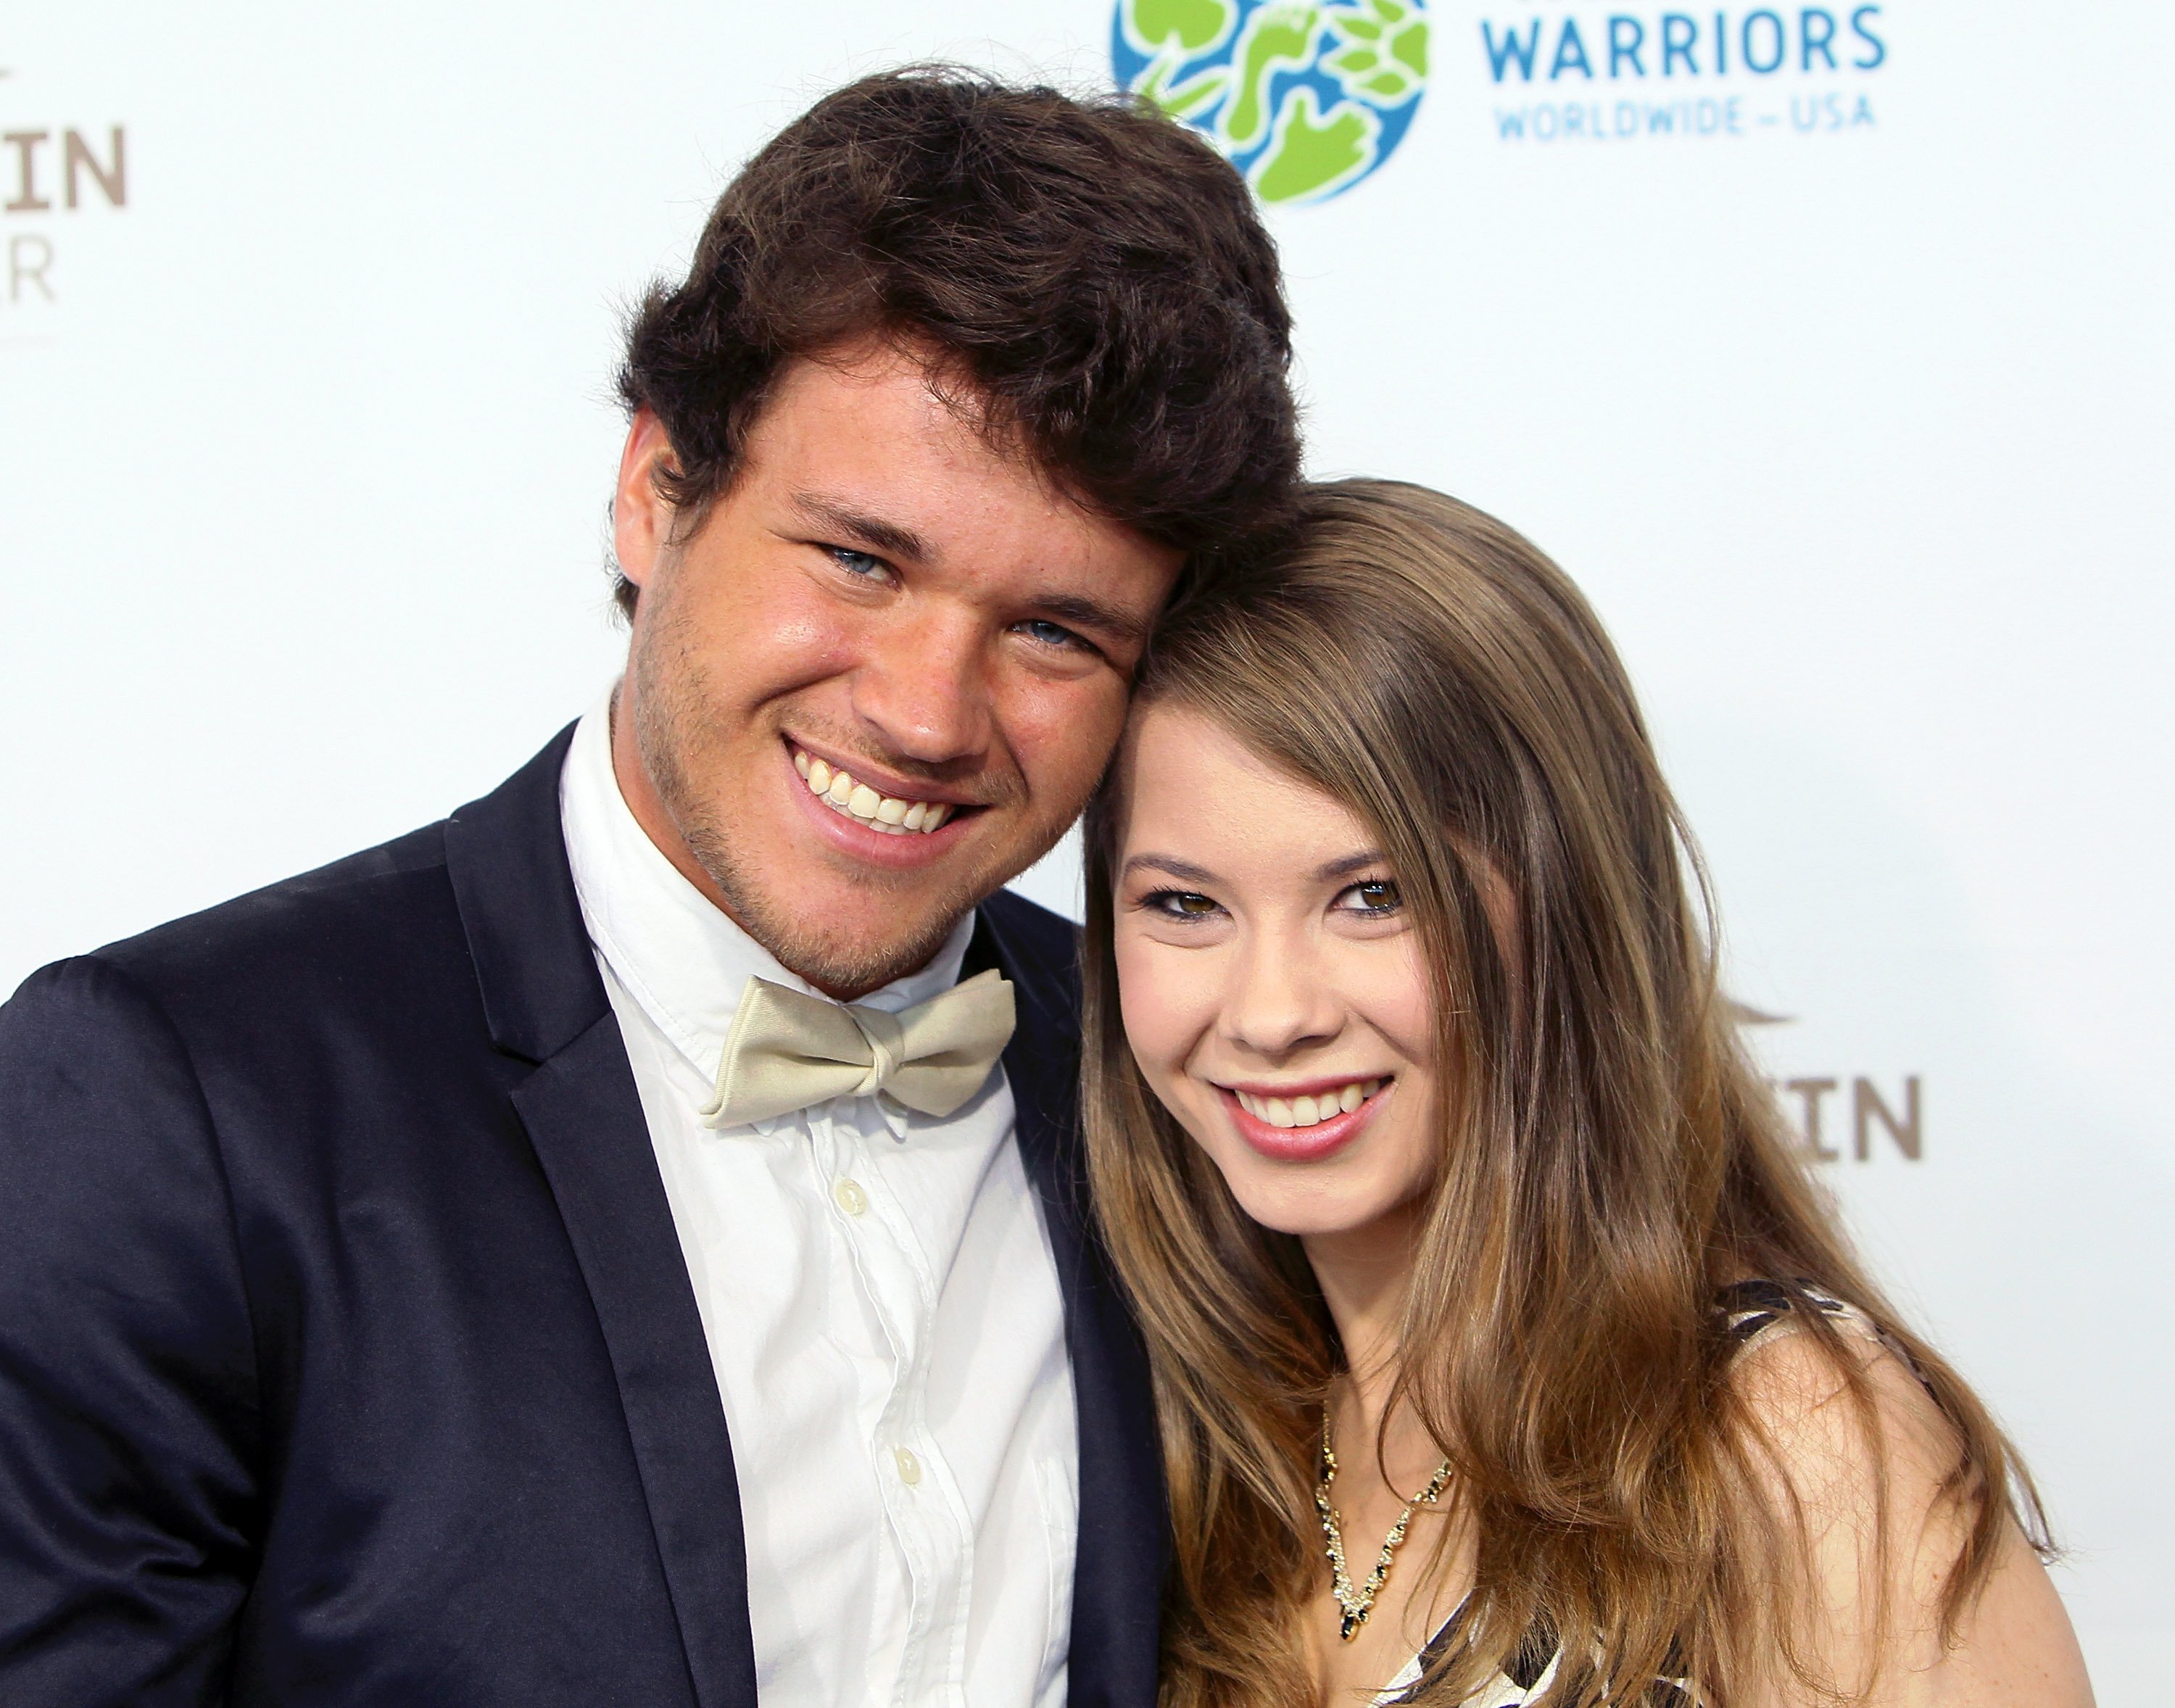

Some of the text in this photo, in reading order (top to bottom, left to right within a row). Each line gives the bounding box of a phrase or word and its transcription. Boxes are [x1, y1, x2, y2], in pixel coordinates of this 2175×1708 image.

[1480, 6, 1886, 83] WARRIORS
[1495, 96, 1743, 141] WORLDWIDE
[1791, 91, 1876, 133] USA
